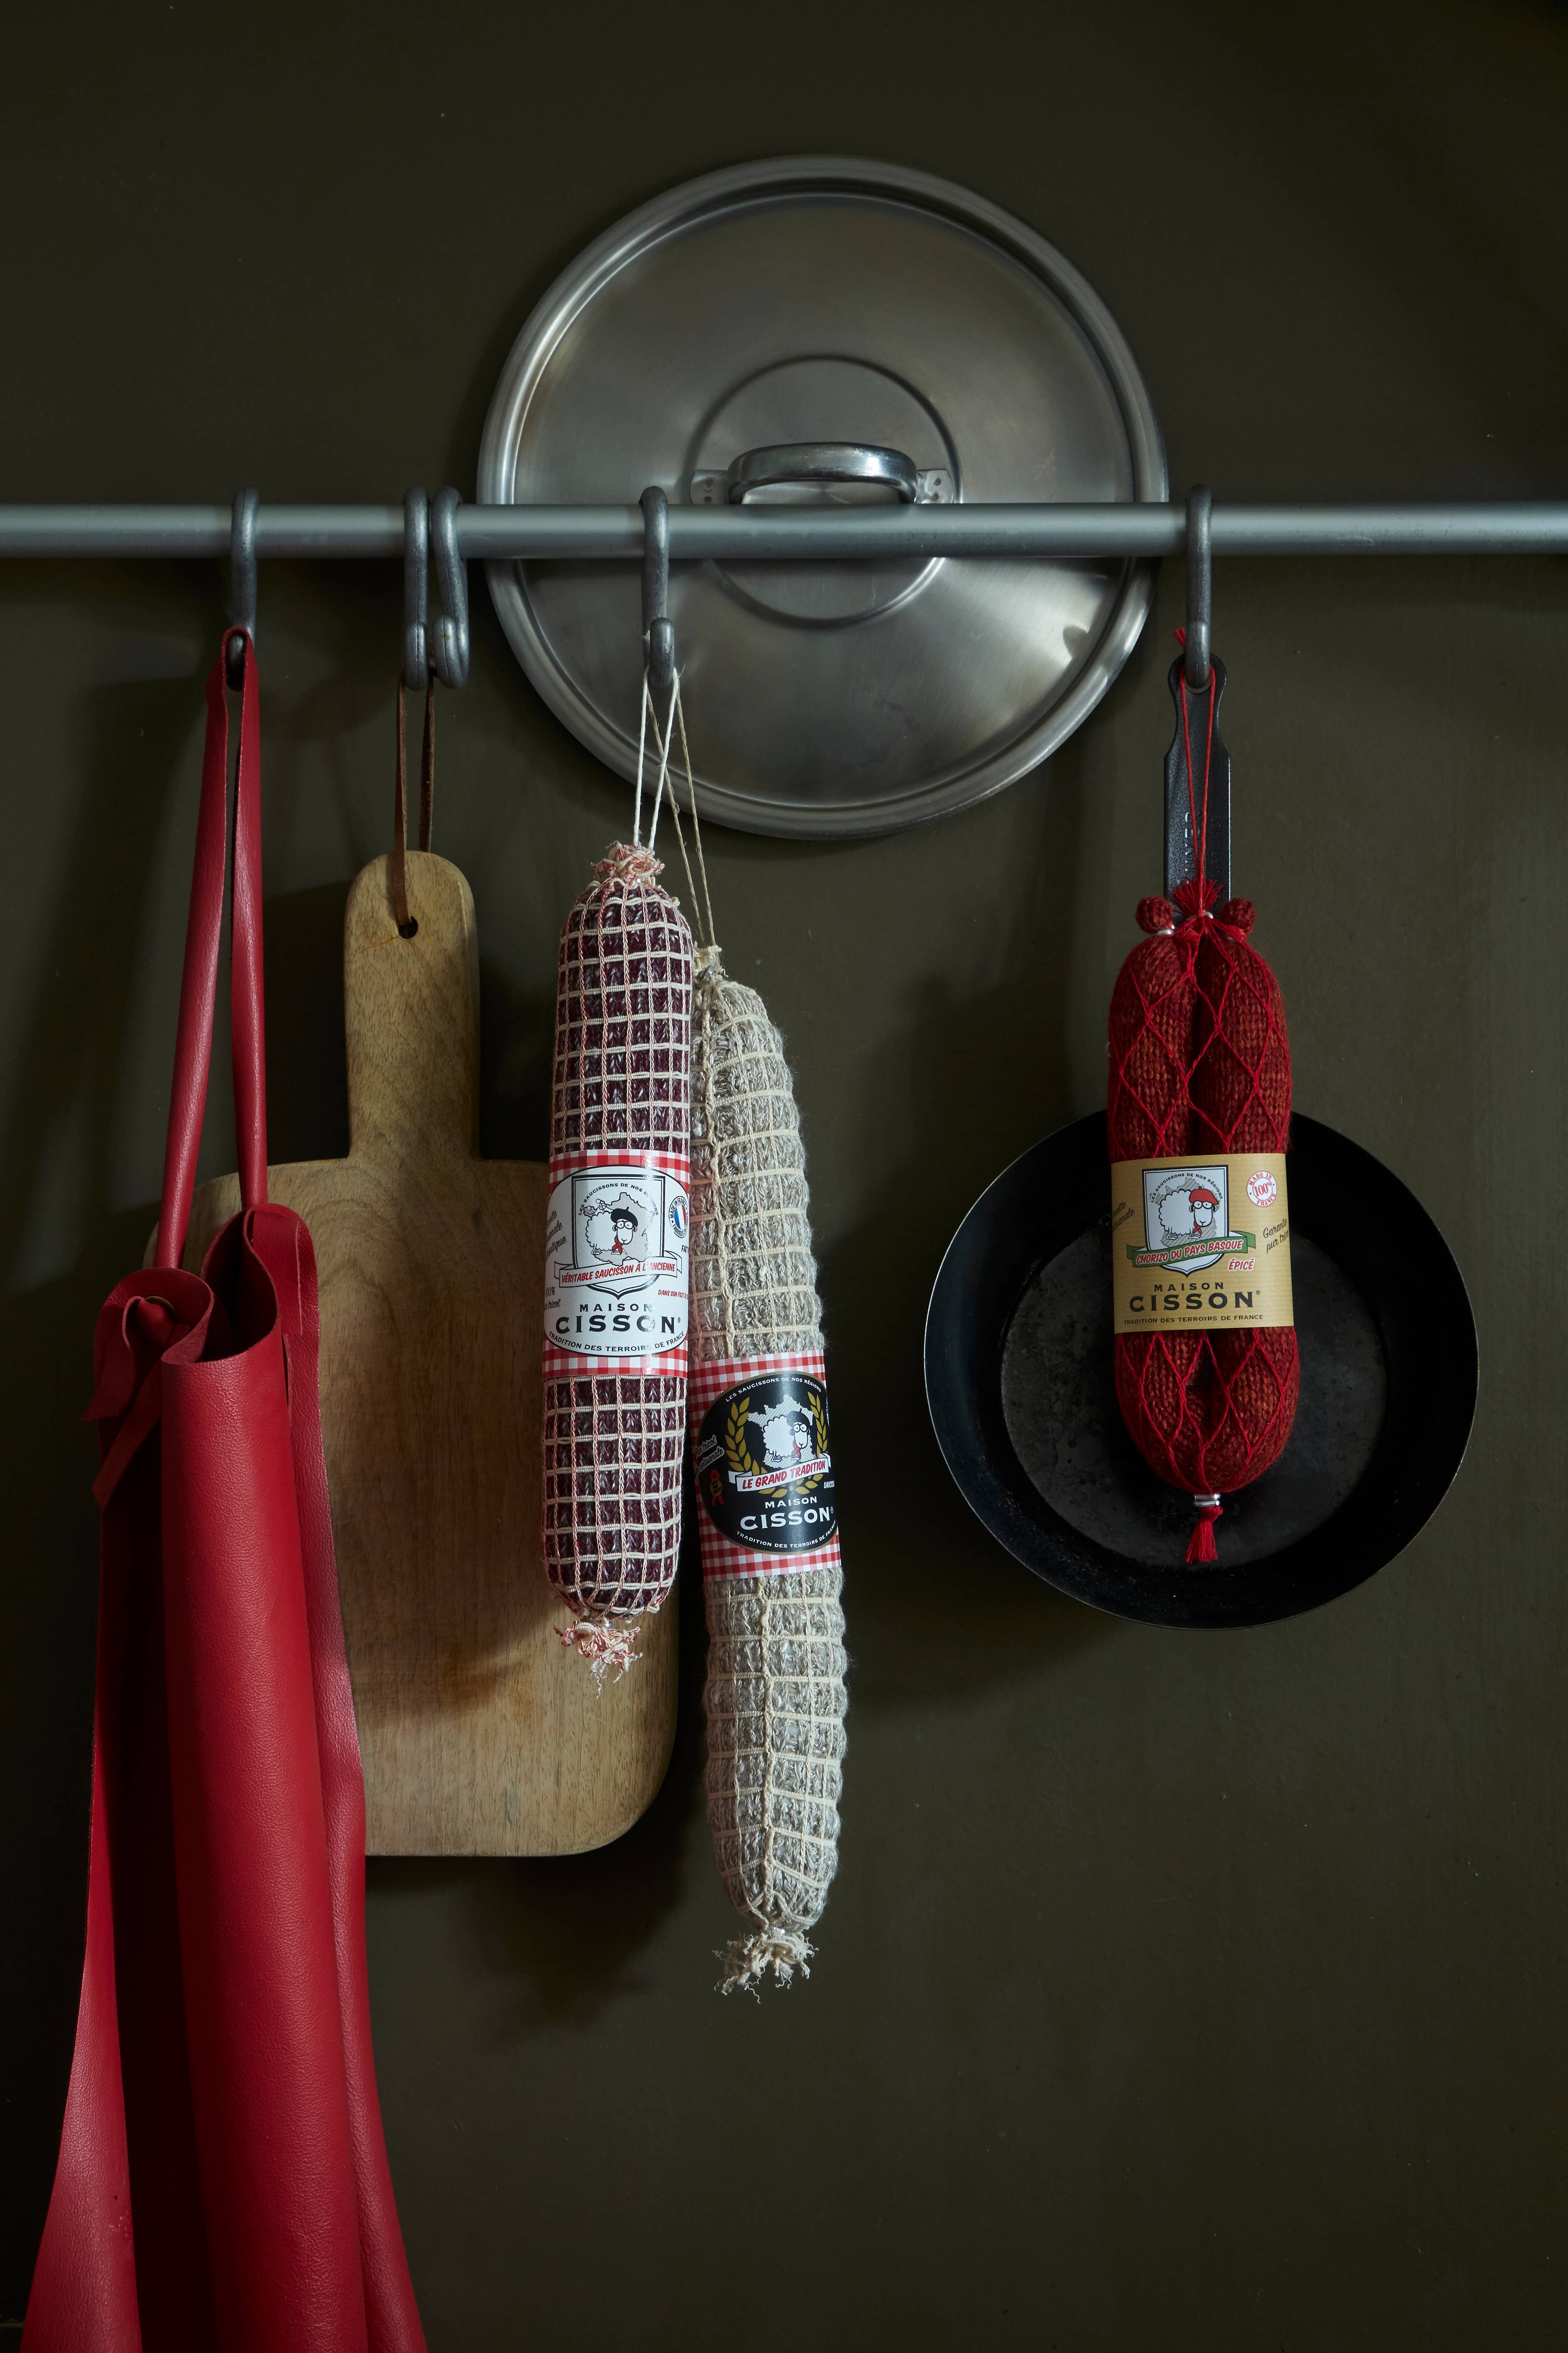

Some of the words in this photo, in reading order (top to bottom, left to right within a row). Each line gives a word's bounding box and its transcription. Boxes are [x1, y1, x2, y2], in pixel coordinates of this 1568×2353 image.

[1155, 1173, 1185, 1192] SAUCISSONS
[1208, 1179, 1223, 1200] RÉGIONS
[1248, 1173, 1264, 1186] MADE
[584, 1183, 618, 1203] SAUCISSONS
[1254, 1181, 1272, 1197] 100%
[1256, 1193, 1276, 1206] FRANCE
[1136, 1253, 1168, 1265] CHORIZO
[1171, 1249, 1182, 1260] DU
[1184, 1244, 1206, 1256] PAYS
[1208, 1239, 1244, 1251] BASQUE
[1266, 1238, 1279, 1254] pur
[562, 1271, 593, 1283] VÉRITABLE
[594, 1265, 634, 1279] SAUCISSON
[635, 1261, 641, 1272] À
[1228, 1257, 1255, 1271] ÉPICÉ
[545, 1287, 555, 1297] 00%
[1154, 1282, 1224, 1292] MAISON
[580, 1304, 652, 1312] MAISON
[548, 1331, 582, 1349] TRADITION
[666, 1331, 684, 1346] FRANCE
[726, 1392, 737, 1402] LES
[738, 1378, 779, 1394] SAUCISSONS
[804, 1379, 821, 1392] RÉGIONS
[742, 1478, 753, 1490] LE
[755, 1471, 787, 1487] GRAND
[790, 1460, 826, 1479] TRADITION
[765, 1496, 817, 1509] MAISON
[737, 1531, 772, 1547] TRADITION
[790, 1539, 818, 1548] TERROIRS
[825, 1519, 836, 1537] FRANCE
